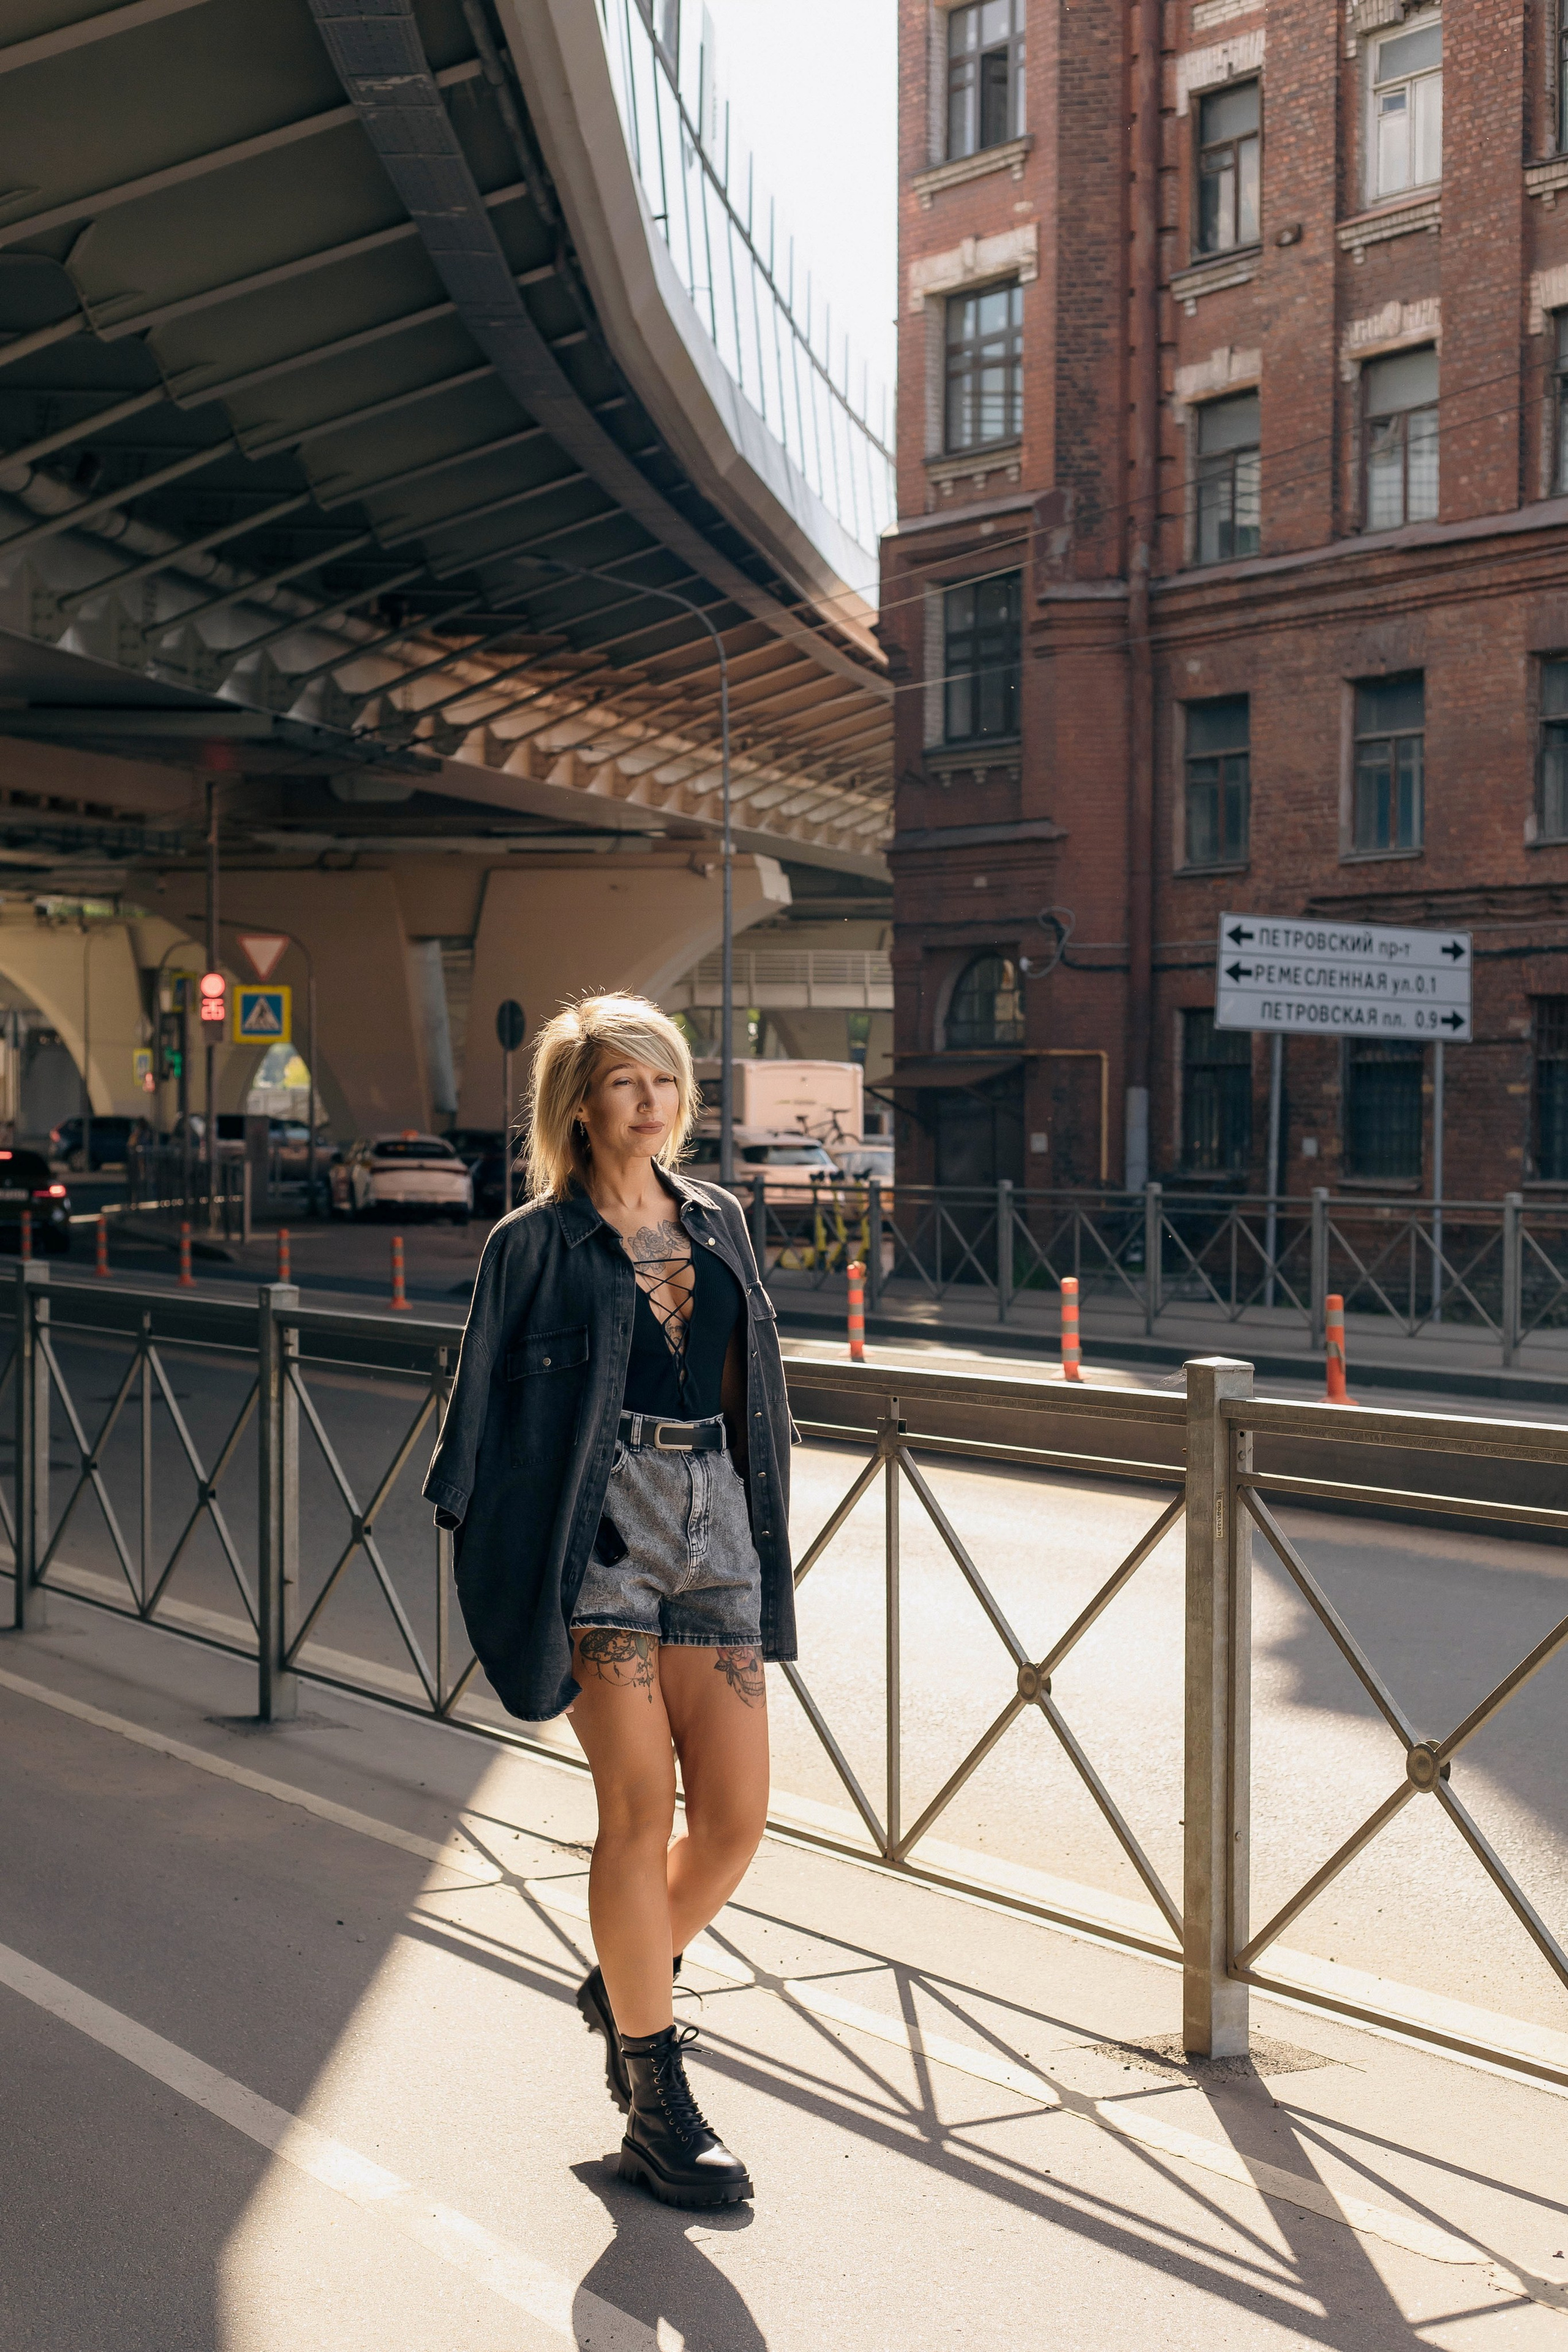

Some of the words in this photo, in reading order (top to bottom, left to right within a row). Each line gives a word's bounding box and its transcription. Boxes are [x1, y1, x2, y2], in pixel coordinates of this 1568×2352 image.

[1259, 927, 1373, 953] ПЕТРОВСКИЙ
[1379, 941, 1411, 959] пр-т
[1255, 964, 1387, 990] РЕМЕСЛЕННАЯ
[1261, 1001, 1378, 1026] ПЕТРОВСКАЯ
[1415, 1010, 1438, 1029] 0.9
